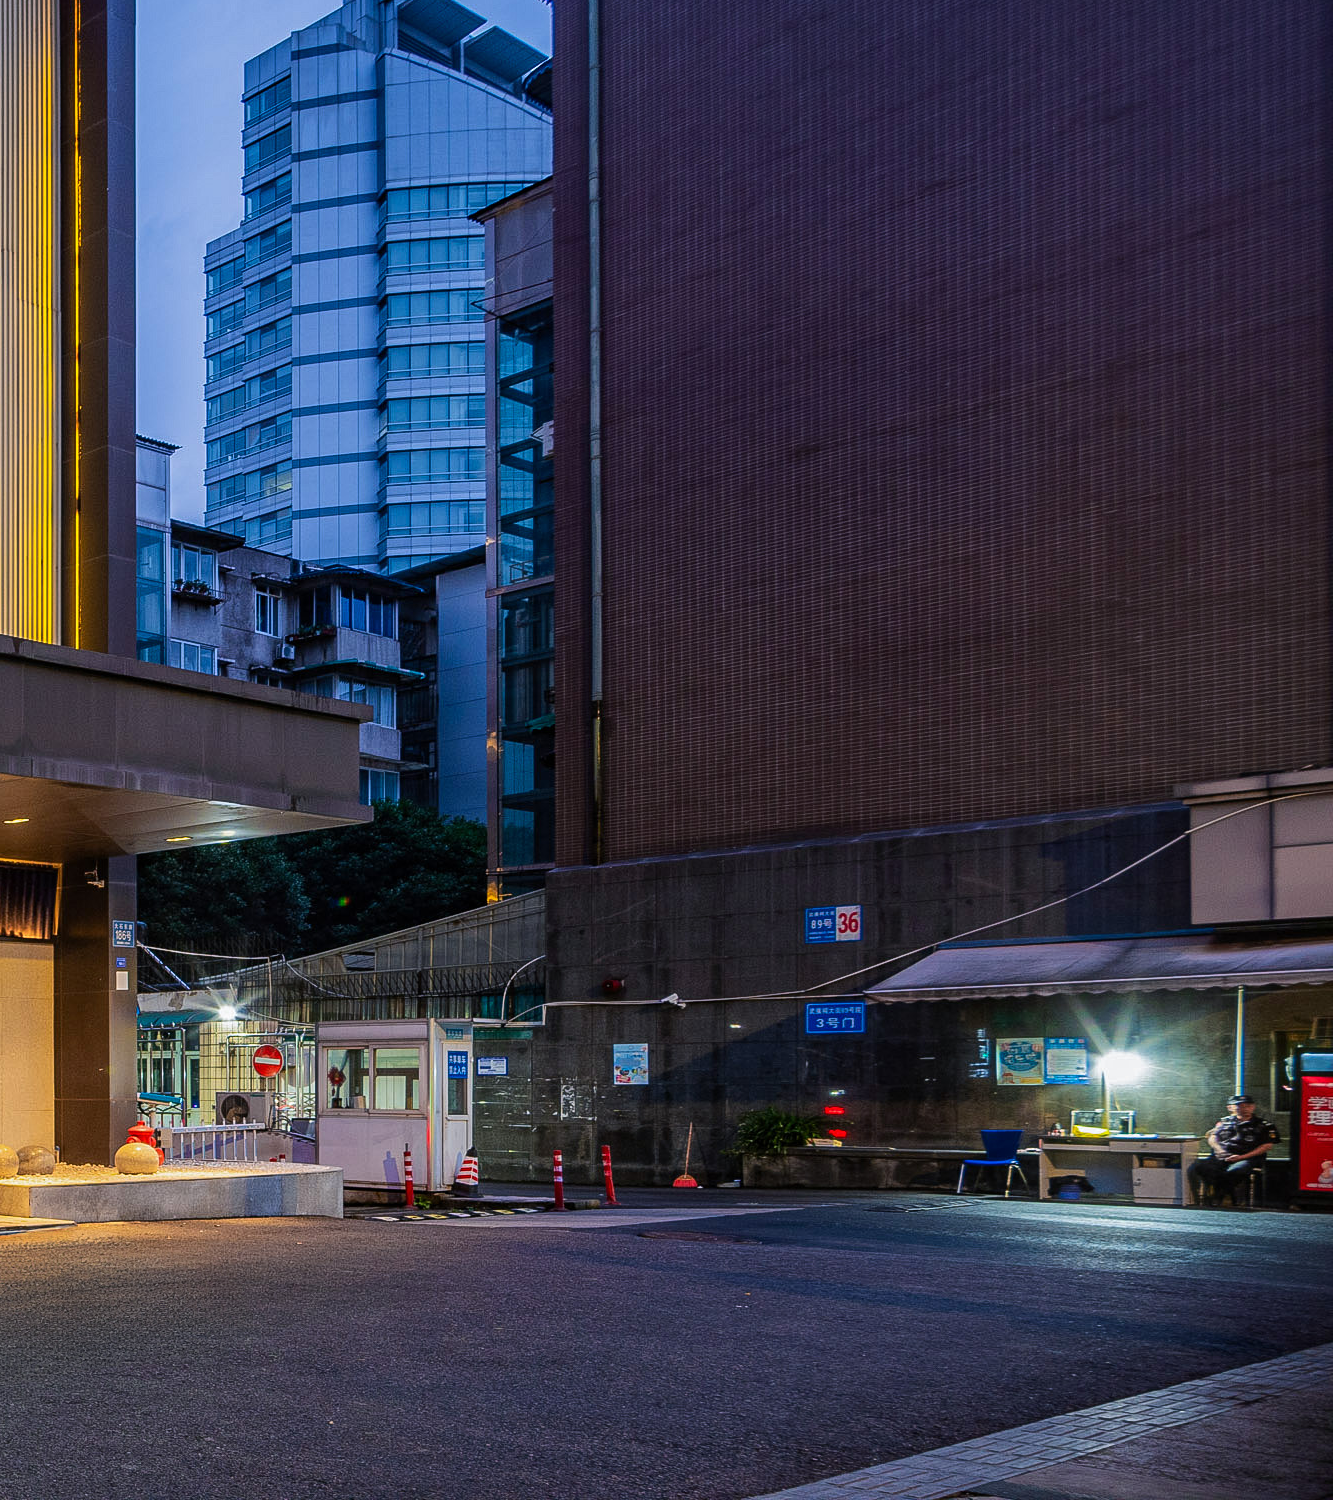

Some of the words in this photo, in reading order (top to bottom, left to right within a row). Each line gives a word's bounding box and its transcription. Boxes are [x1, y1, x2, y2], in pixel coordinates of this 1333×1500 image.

[811, 918, 833, 930] 89号
[837, 911, 859, 934] 36
[815, 1017, 856, 1029] 3号门
